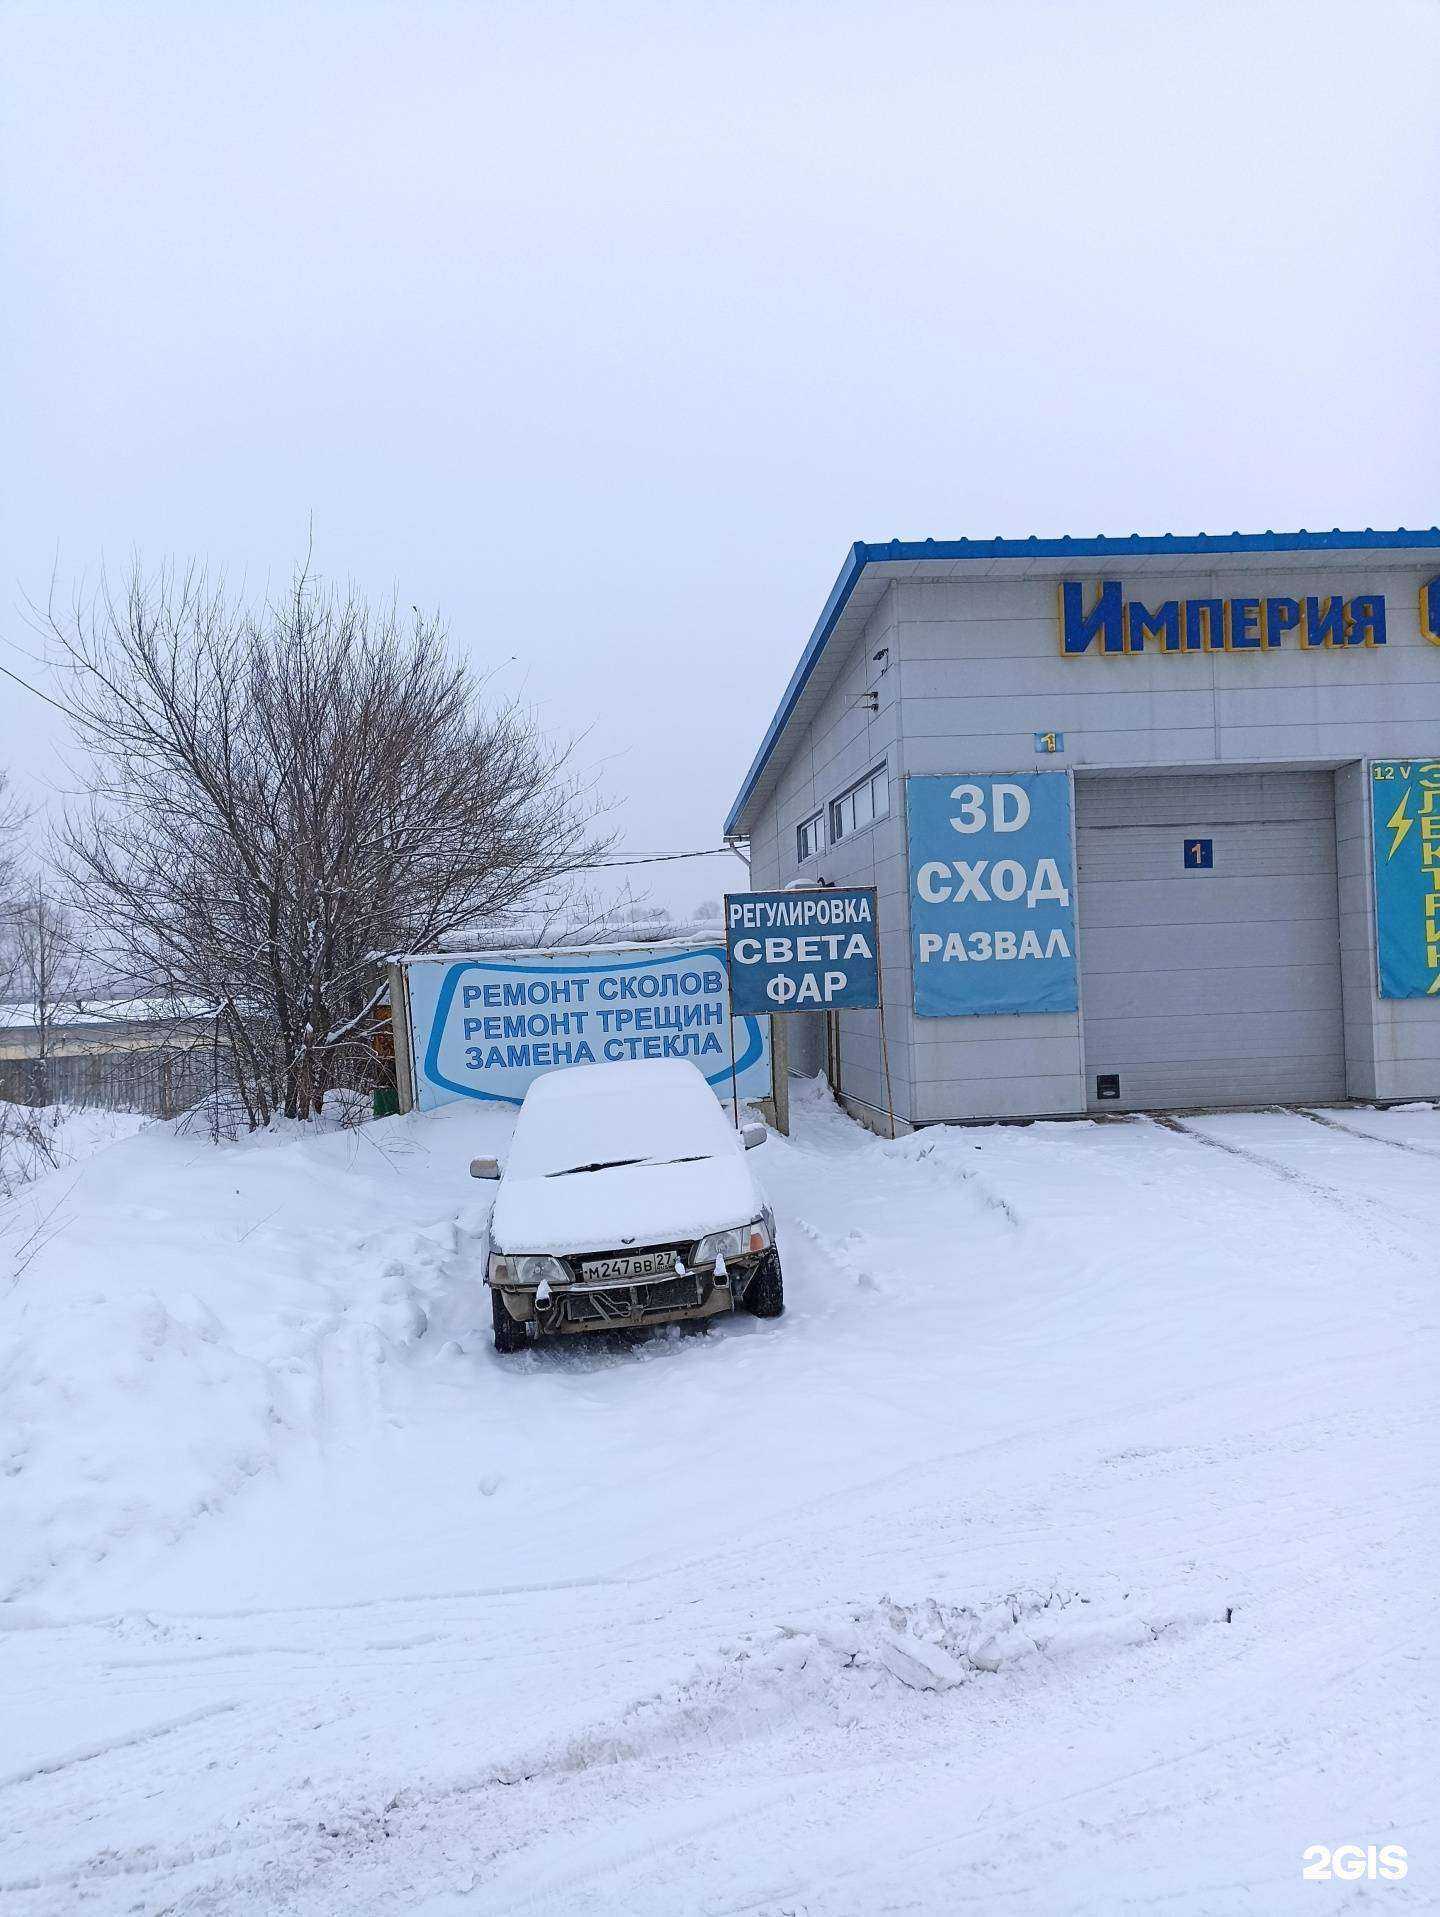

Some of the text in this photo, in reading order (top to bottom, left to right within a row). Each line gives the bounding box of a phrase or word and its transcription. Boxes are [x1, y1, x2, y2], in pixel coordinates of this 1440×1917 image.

[1058, 580, 1387, 656] ИМПЕРИЯ
[1374, 766, 1411, 780] 12 V
[949, 783, 1031, 834] 3D
[1191, 843, 1202, 864] 1
[916, 858, 1069, 908] СХОД
[729, 897, 872, 929] РЕГУЛИРОВКА
[733, 933, 873, 965] СВЕТА
[919, 928, 1071, 963] РАЗВАЛ
[463, 971, 723, 1009] РЕМОНТ СКОЛОВ
[766, 971, 848, 1005] ФАР
[464, 1002, 723, 1041] РЕМОНТ ТРЕЩИН
[465, 1032, 723, 1070] ЗАМЕНА СТЕКЛА
[656, 1252, 672, 1266] 27
